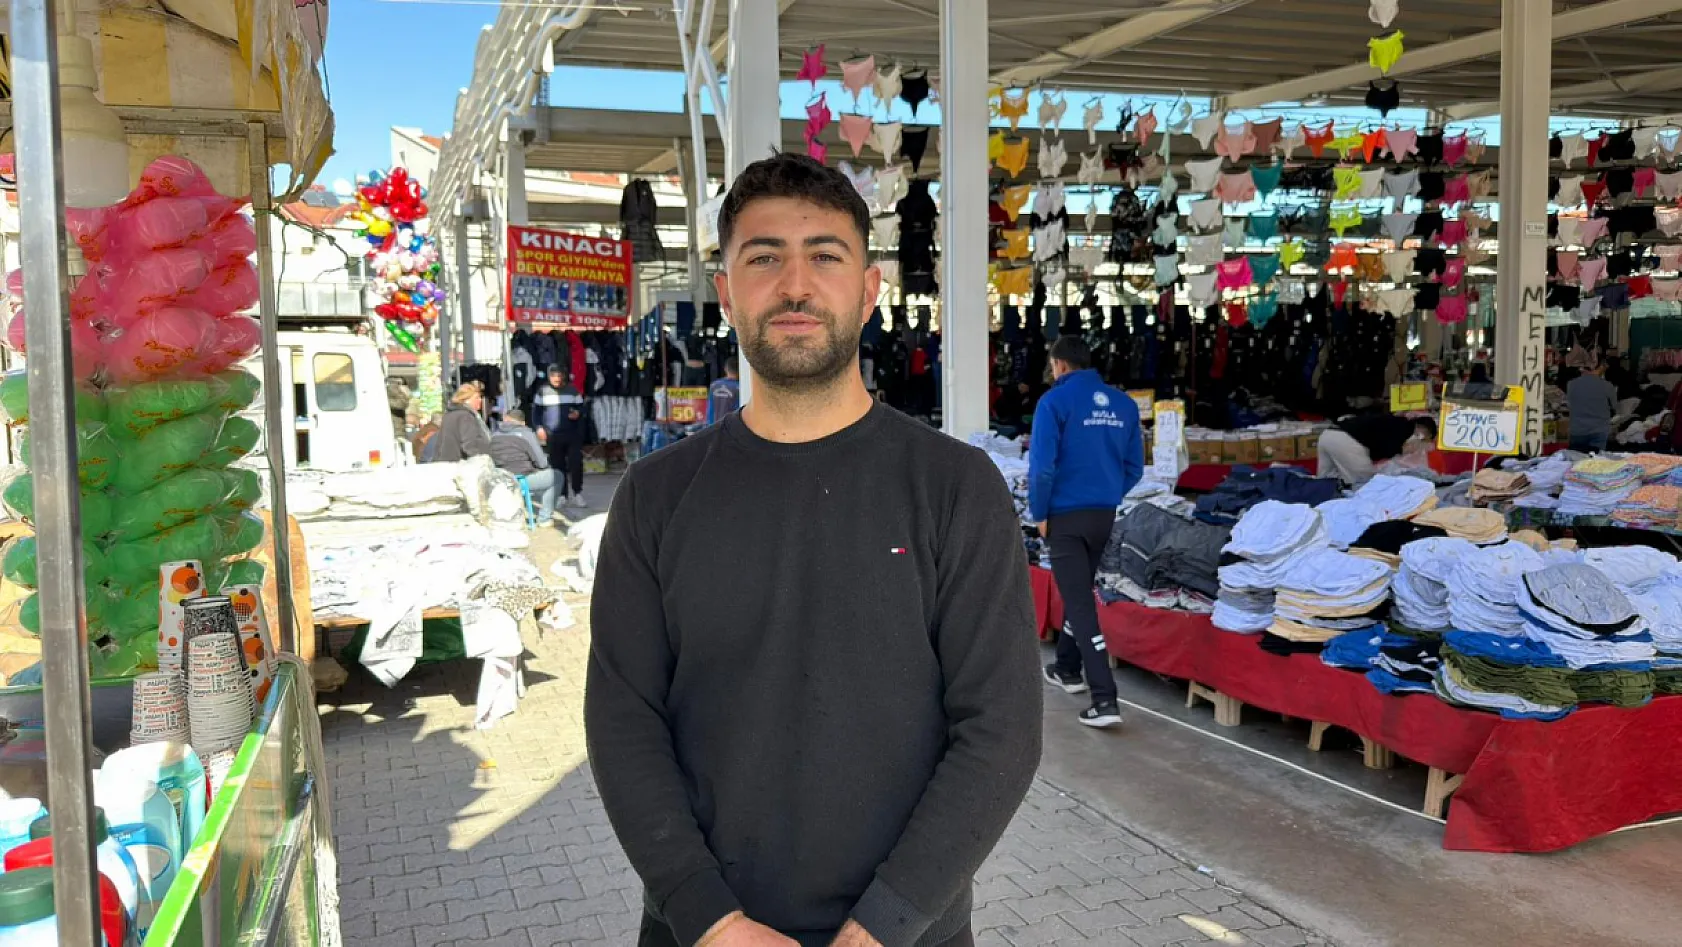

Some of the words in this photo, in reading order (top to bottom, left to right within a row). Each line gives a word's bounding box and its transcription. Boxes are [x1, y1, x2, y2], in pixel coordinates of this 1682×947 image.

[521, 231, 623, 258] KINACI
[516, 249, 554, 262] SPOR
[516, 262, 545, 274] DEV
[549, 264, 625, 284] KAMPANYA
[672, 405, 695, 421] 50
